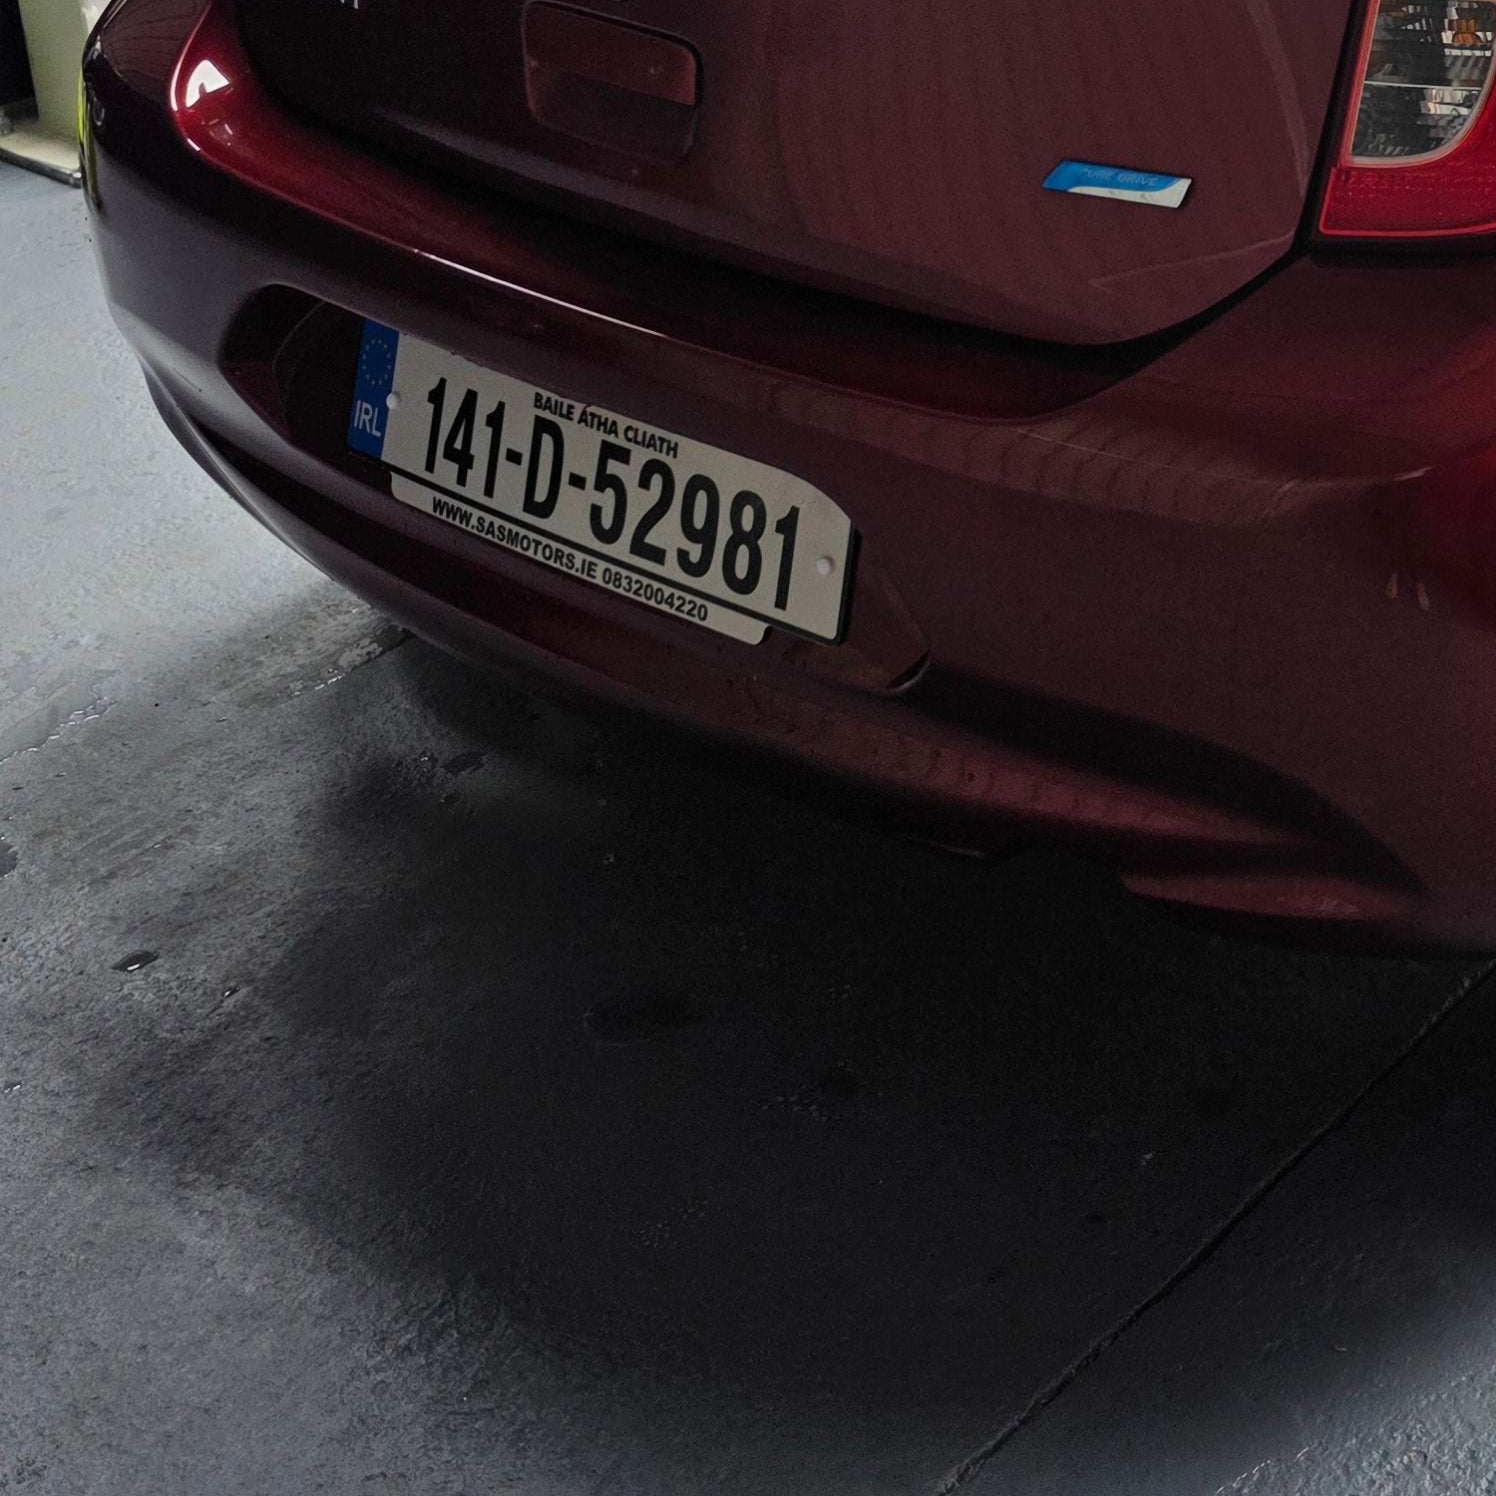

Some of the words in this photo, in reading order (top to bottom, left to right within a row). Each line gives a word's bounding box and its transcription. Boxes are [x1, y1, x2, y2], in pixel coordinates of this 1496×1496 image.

[353, 399, 382, 438] IRL
[533, 392, 575, 422] BAILE
[623, 425, 679, 459] CLIATH
[425, 377, 800, 611] 141-D-52981
[432, 496, 597, 580] WWW.SASMOTORS.IE
[601, 566, 709, 623] 0832004220
